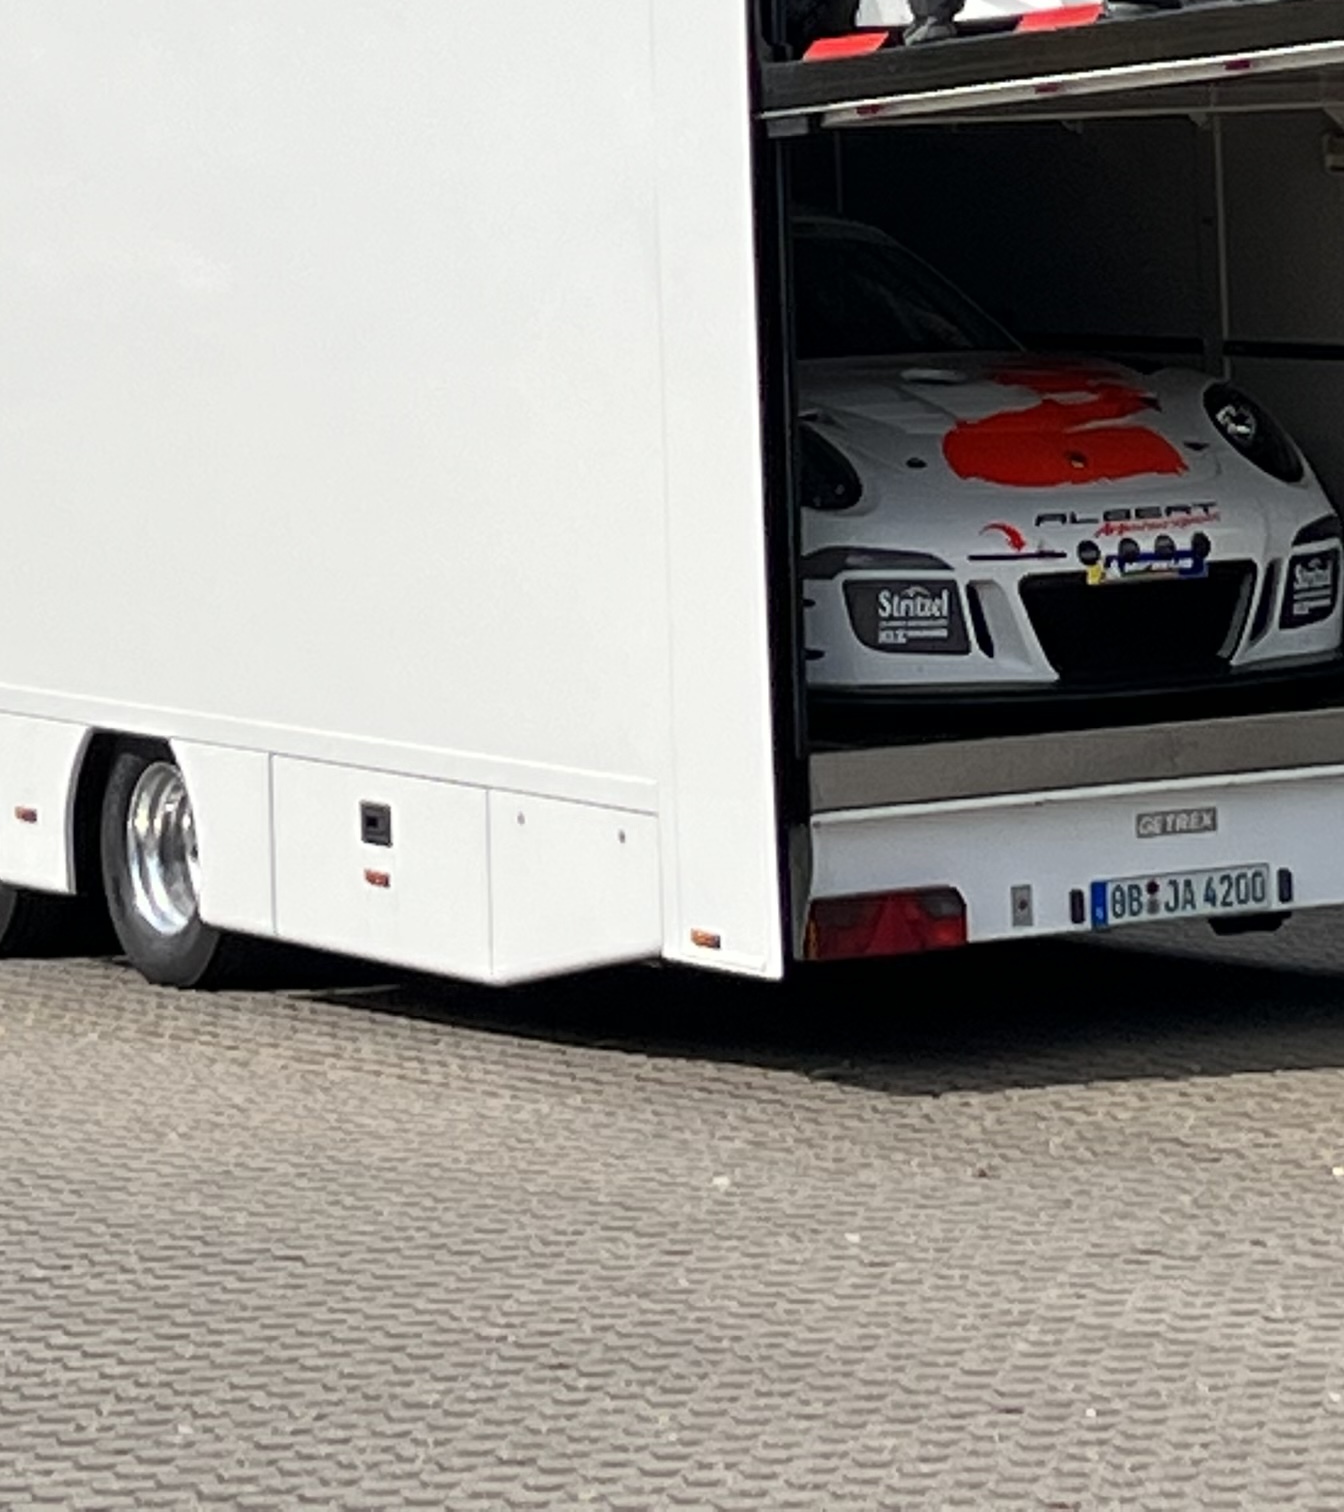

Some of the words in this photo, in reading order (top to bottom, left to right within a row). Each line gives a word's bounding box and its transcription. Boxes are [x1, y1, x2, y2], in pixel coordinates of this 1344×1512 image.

[1034, 500, 1218, 527] ALBERT
[1163, 878, 1197, 913] JA
[1203, 870, 1266, 909] 4200
